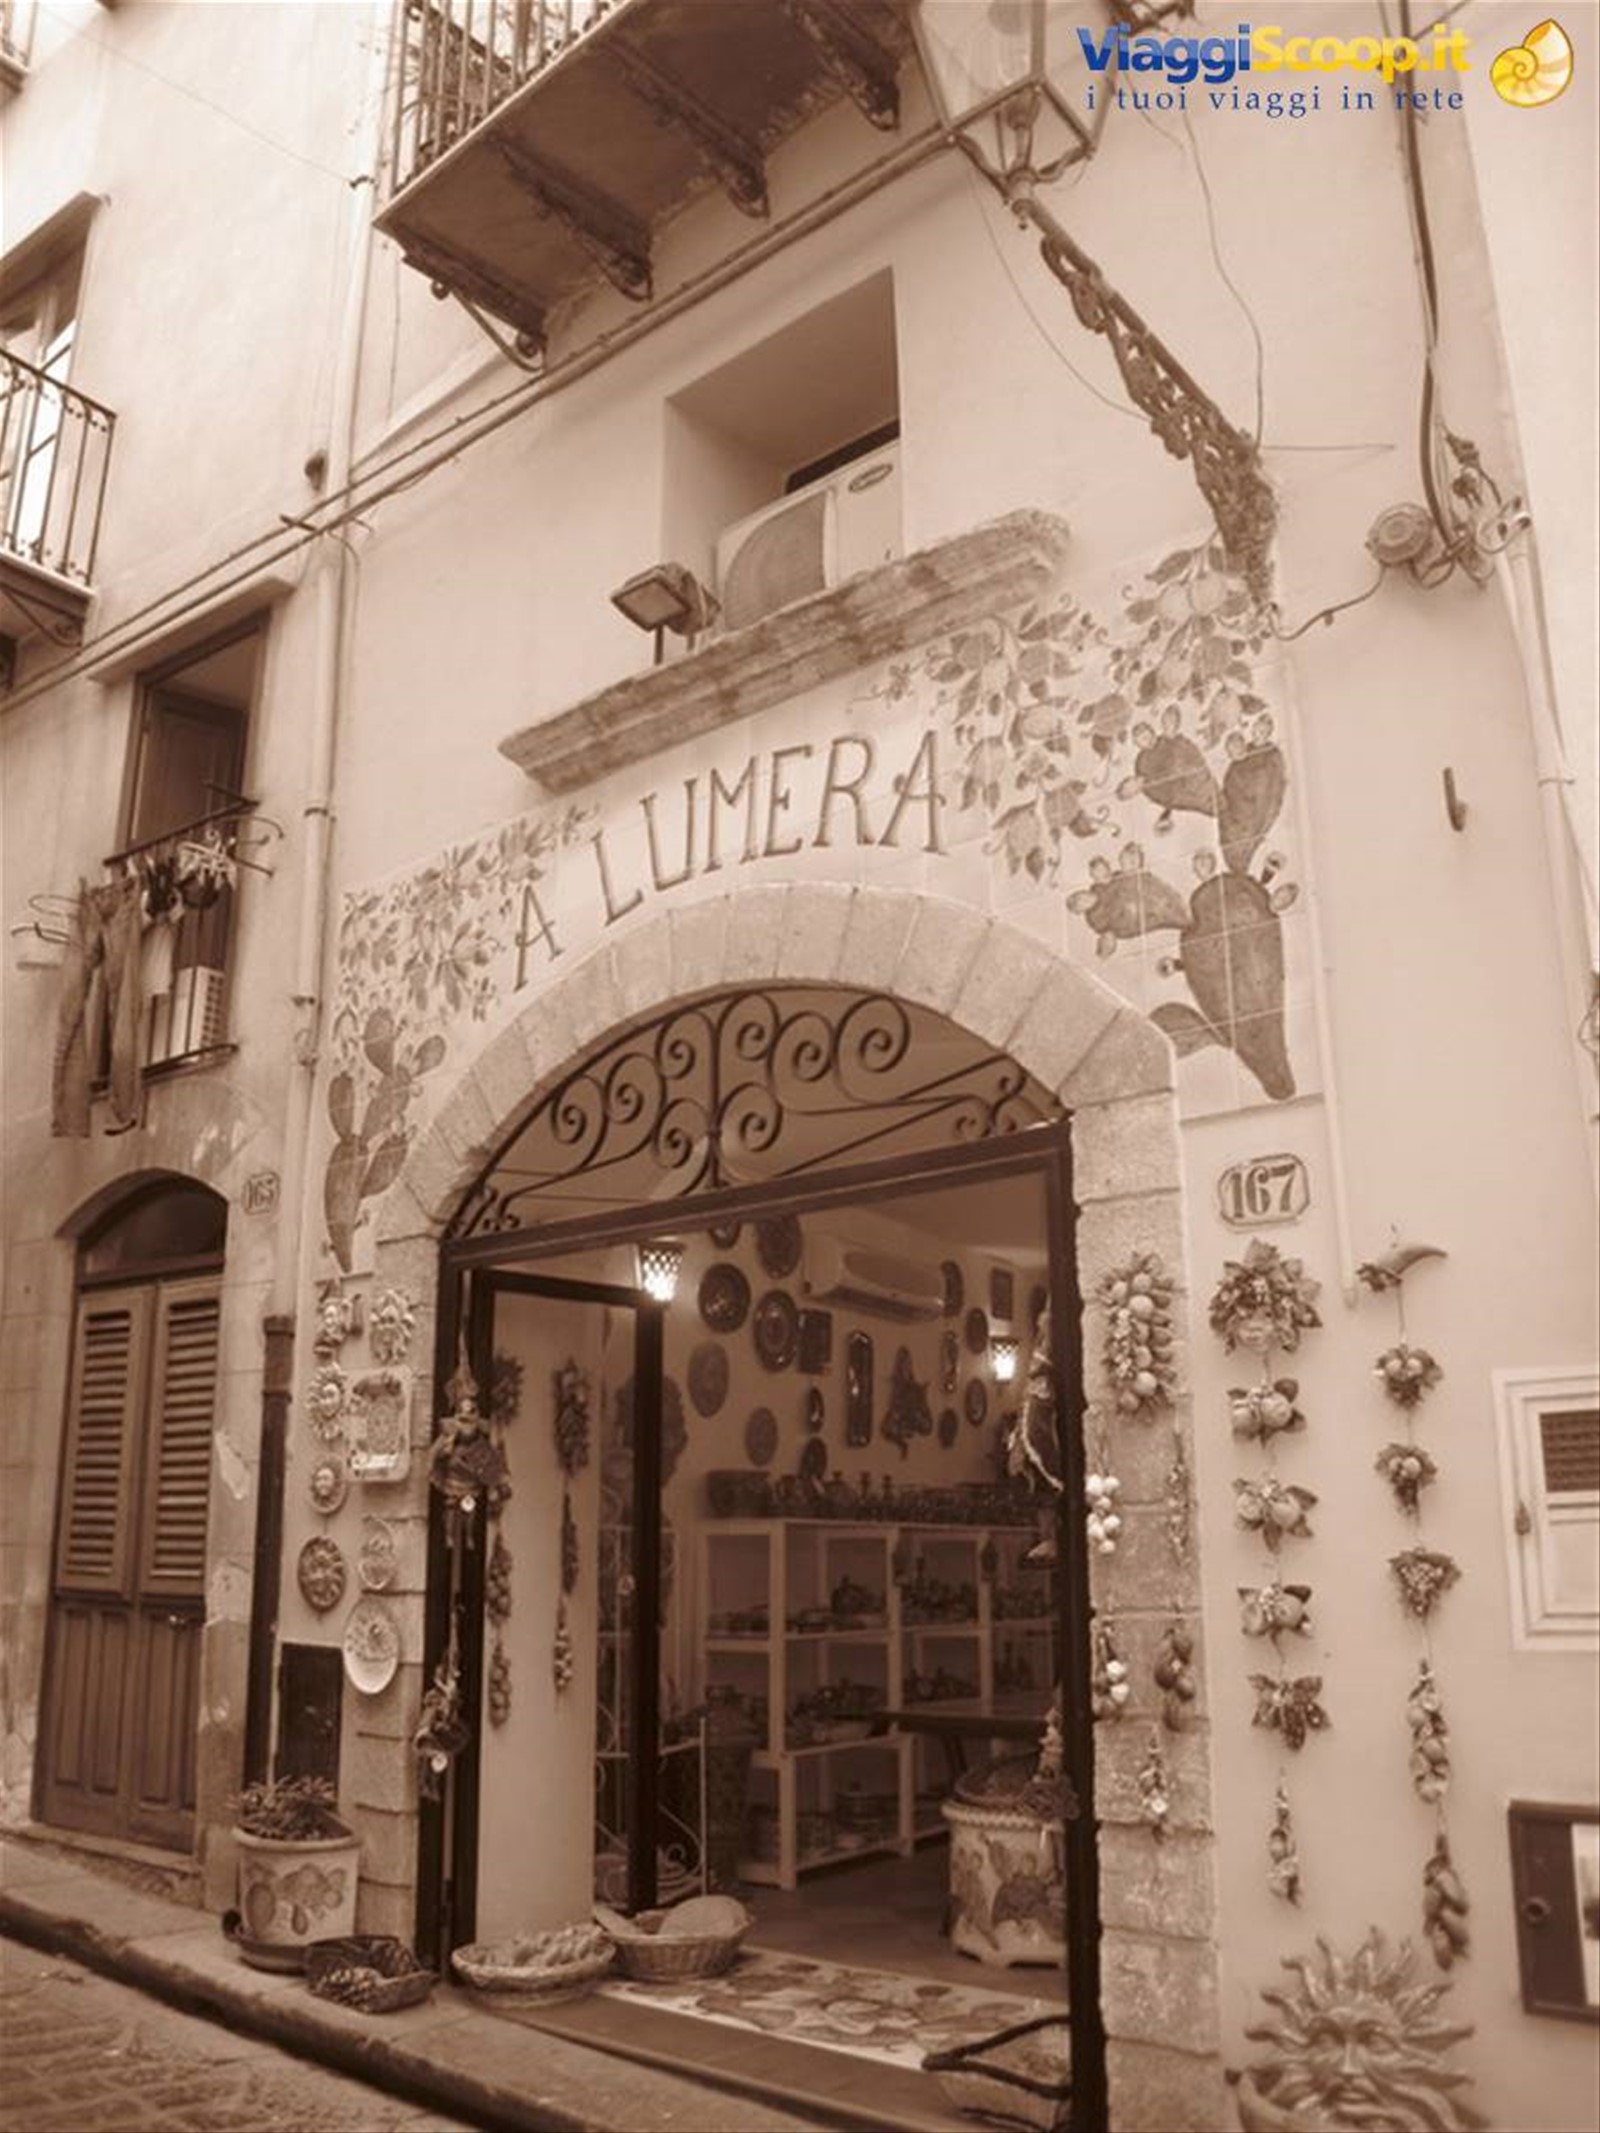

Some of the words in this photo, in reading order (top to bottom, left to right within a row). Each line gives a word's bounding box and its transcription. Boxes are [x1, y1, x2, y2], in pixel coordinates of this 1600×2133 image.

[514, 885, 563, 992] A
[592, 730, 947, 926] LUMERA
[1229, 1162, 1296, 1219] 167
